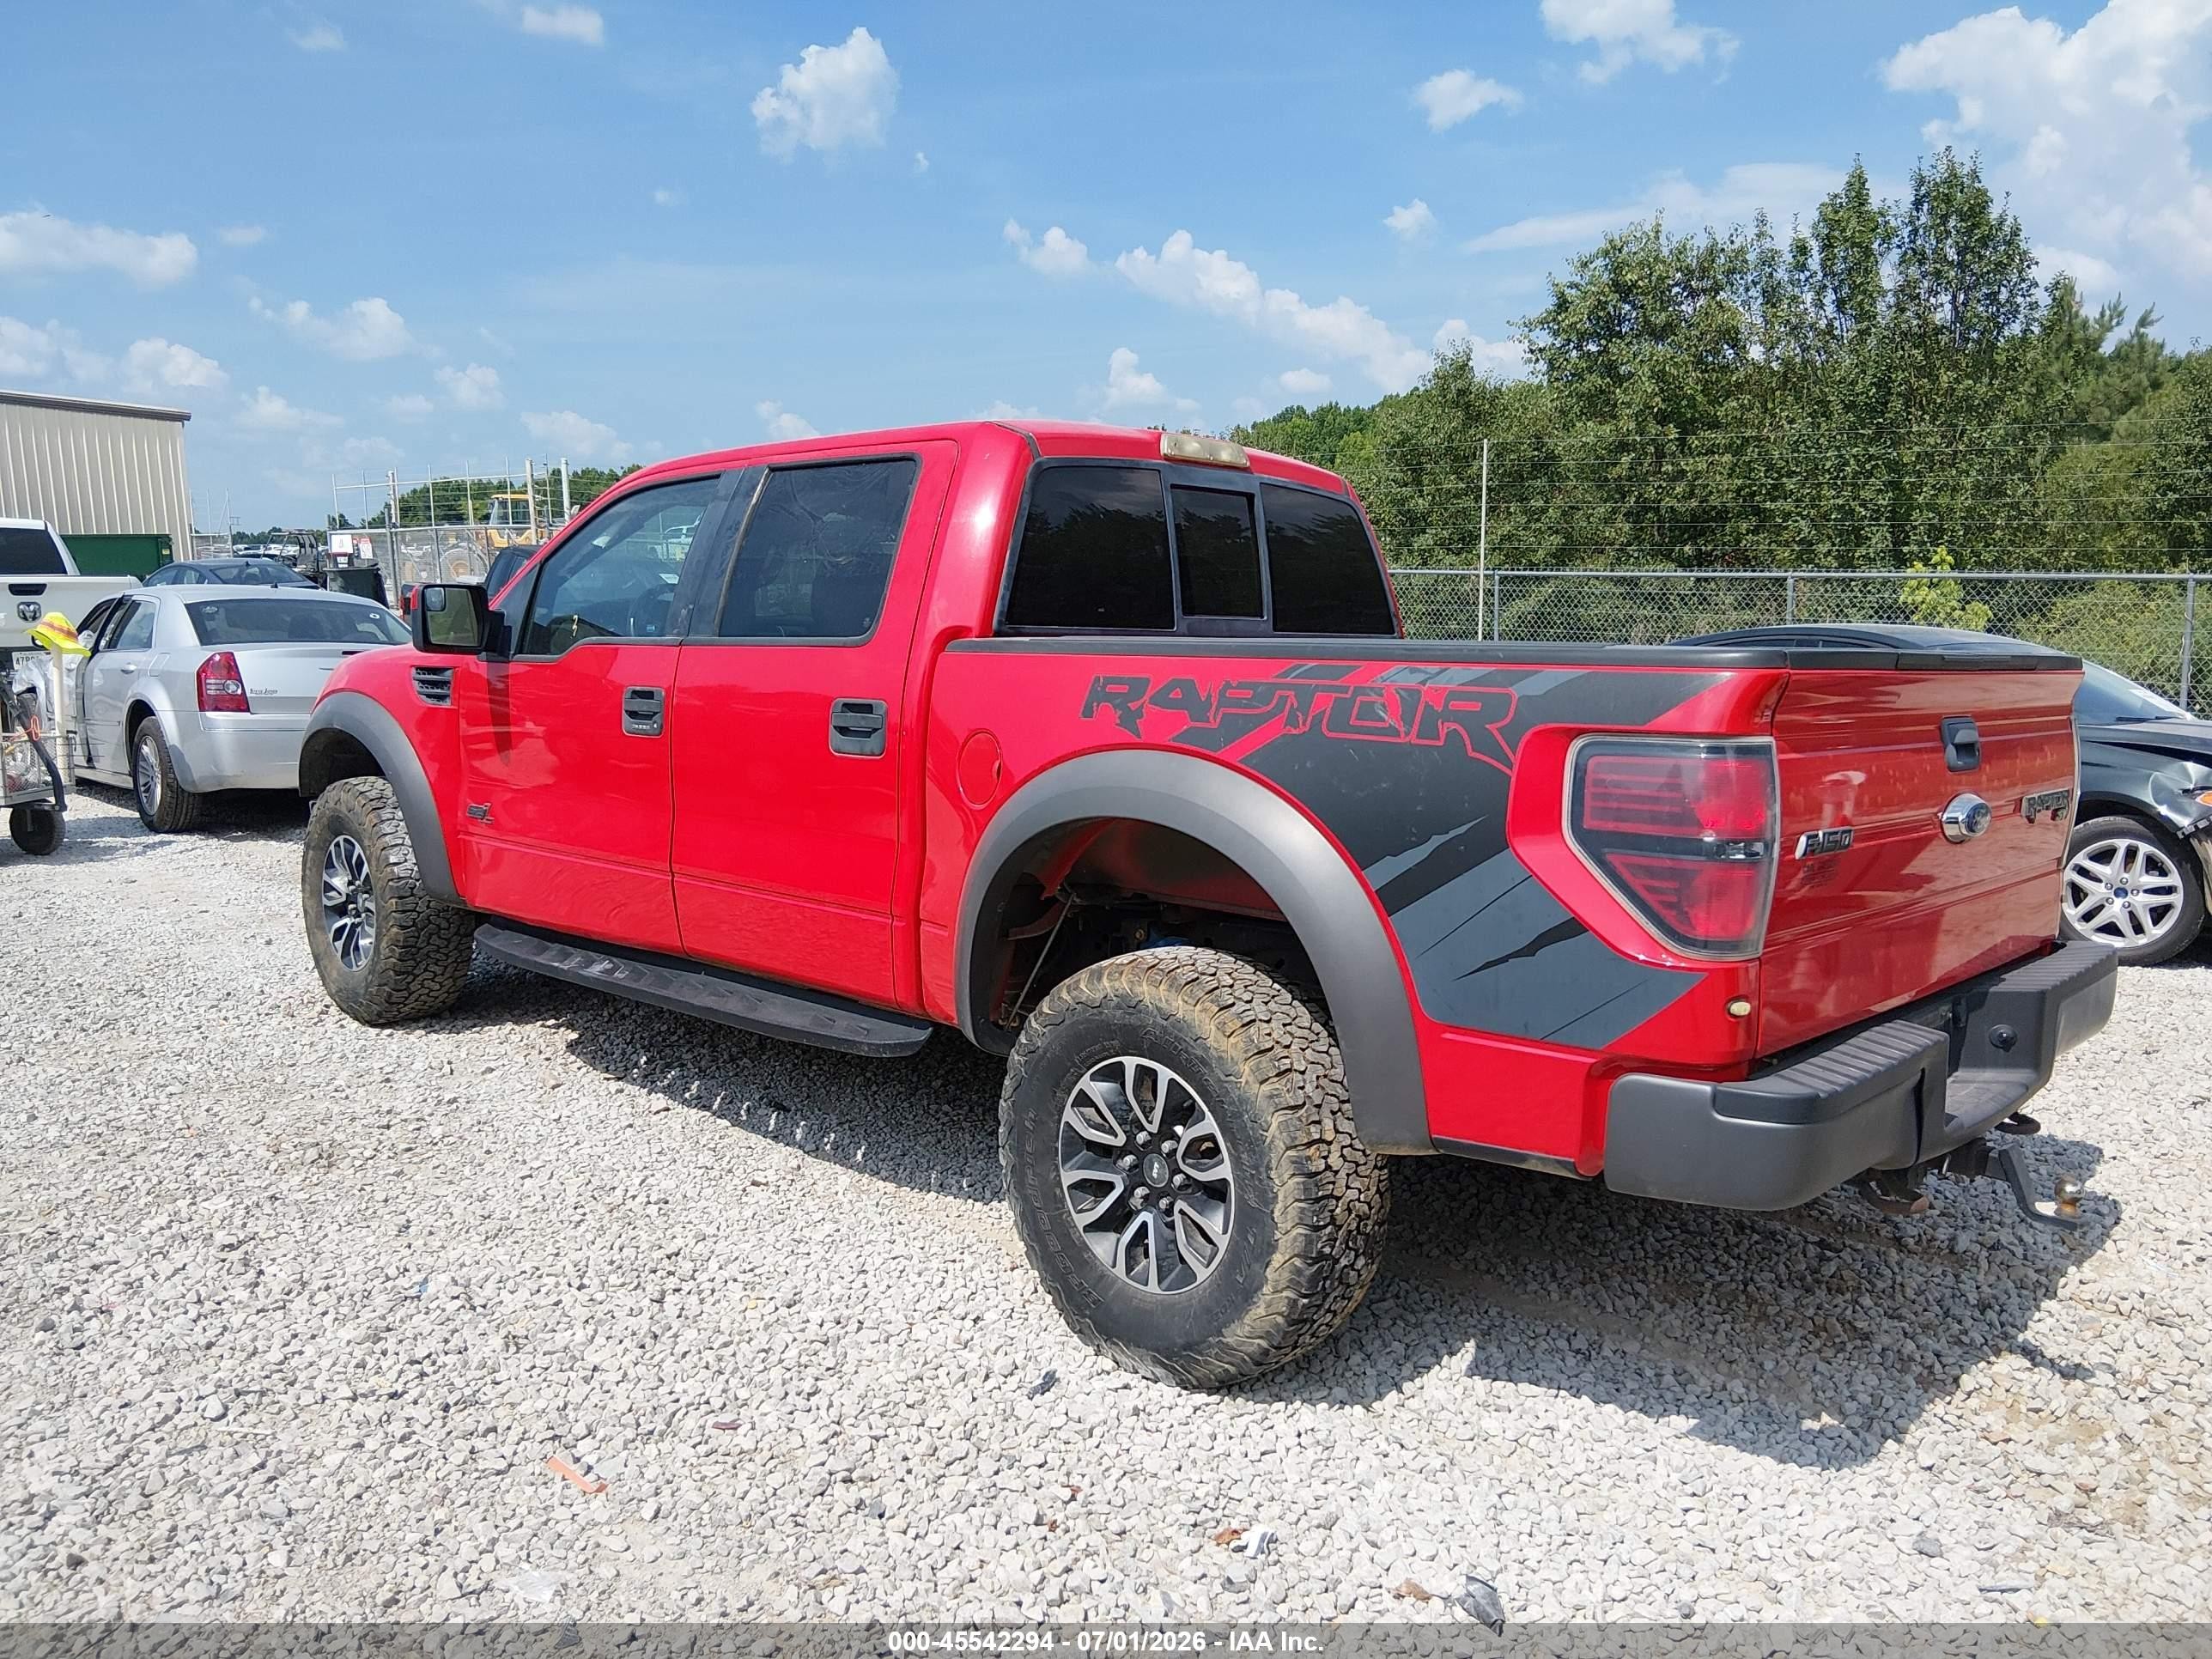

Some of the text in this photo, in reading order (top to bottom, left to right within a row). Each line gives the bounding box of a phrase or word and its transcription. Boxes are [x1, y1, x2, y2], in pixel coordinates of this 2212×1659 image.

[1079, 674, 1518, 777] RAPTOR
[2021, 789, 2070, 823] RAPTOR
[1794, 826, 1854, 860] F-150
[1024, 1108, 1105, 1310] BFGoodrich
